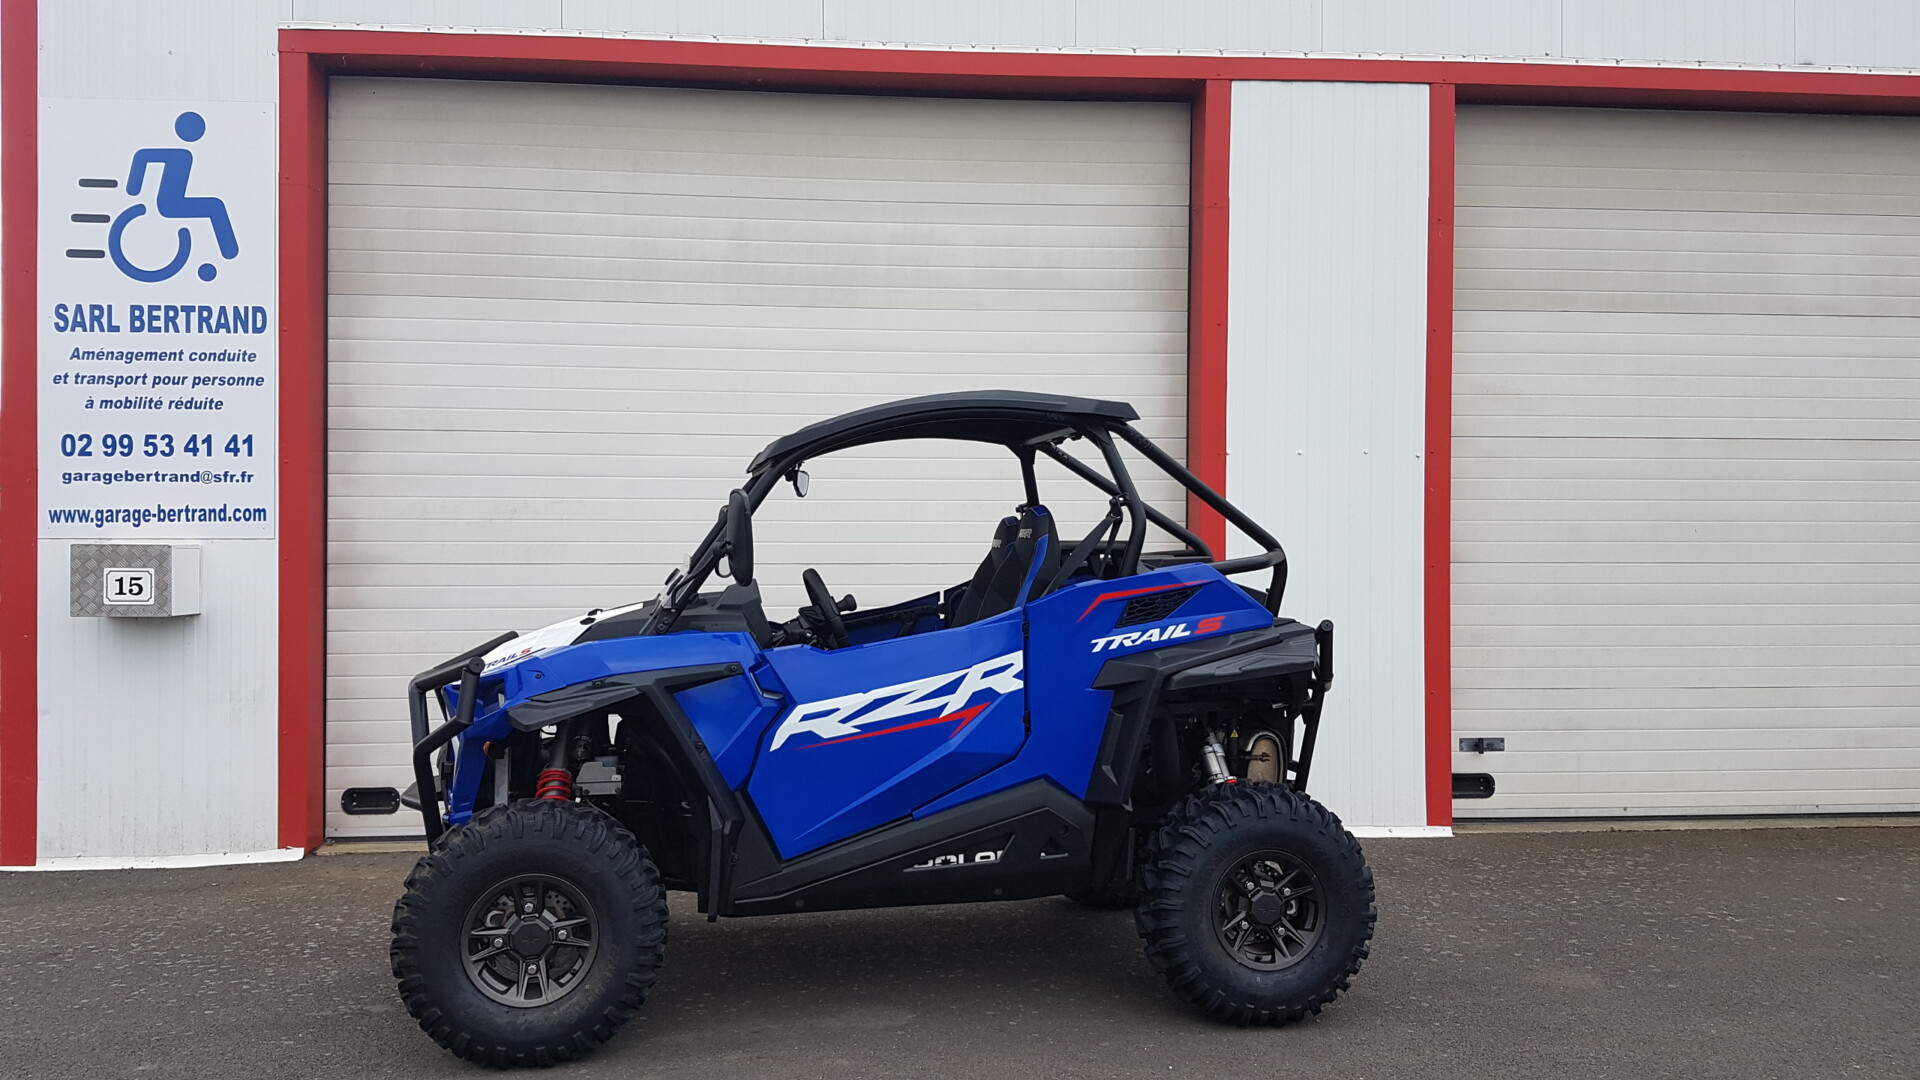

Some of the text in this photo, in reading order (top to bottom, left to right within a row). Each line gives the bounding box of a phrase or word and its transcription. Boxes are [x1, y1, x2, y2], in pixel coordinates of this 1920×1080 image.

[54, 303, 267, 334] SARL BERTRAND
[70, 348, 256, 364] Aménagement conduite
[53, 373, 264, 388] et transport pour personne
[85, 396, 223, 410] à mobilité réduite
[61, 434, 252, 457] 02 99 53 41 41
[62, 470, 254, 484] garagebertrand@sfr.fr
[48, 504, 267, 527] www.garage-bertrand.com
[115, 577, 143, 595] 15
[1090, 616, 1226, 653] TRAIL S
[769, 650, 1024, 752] RZR
